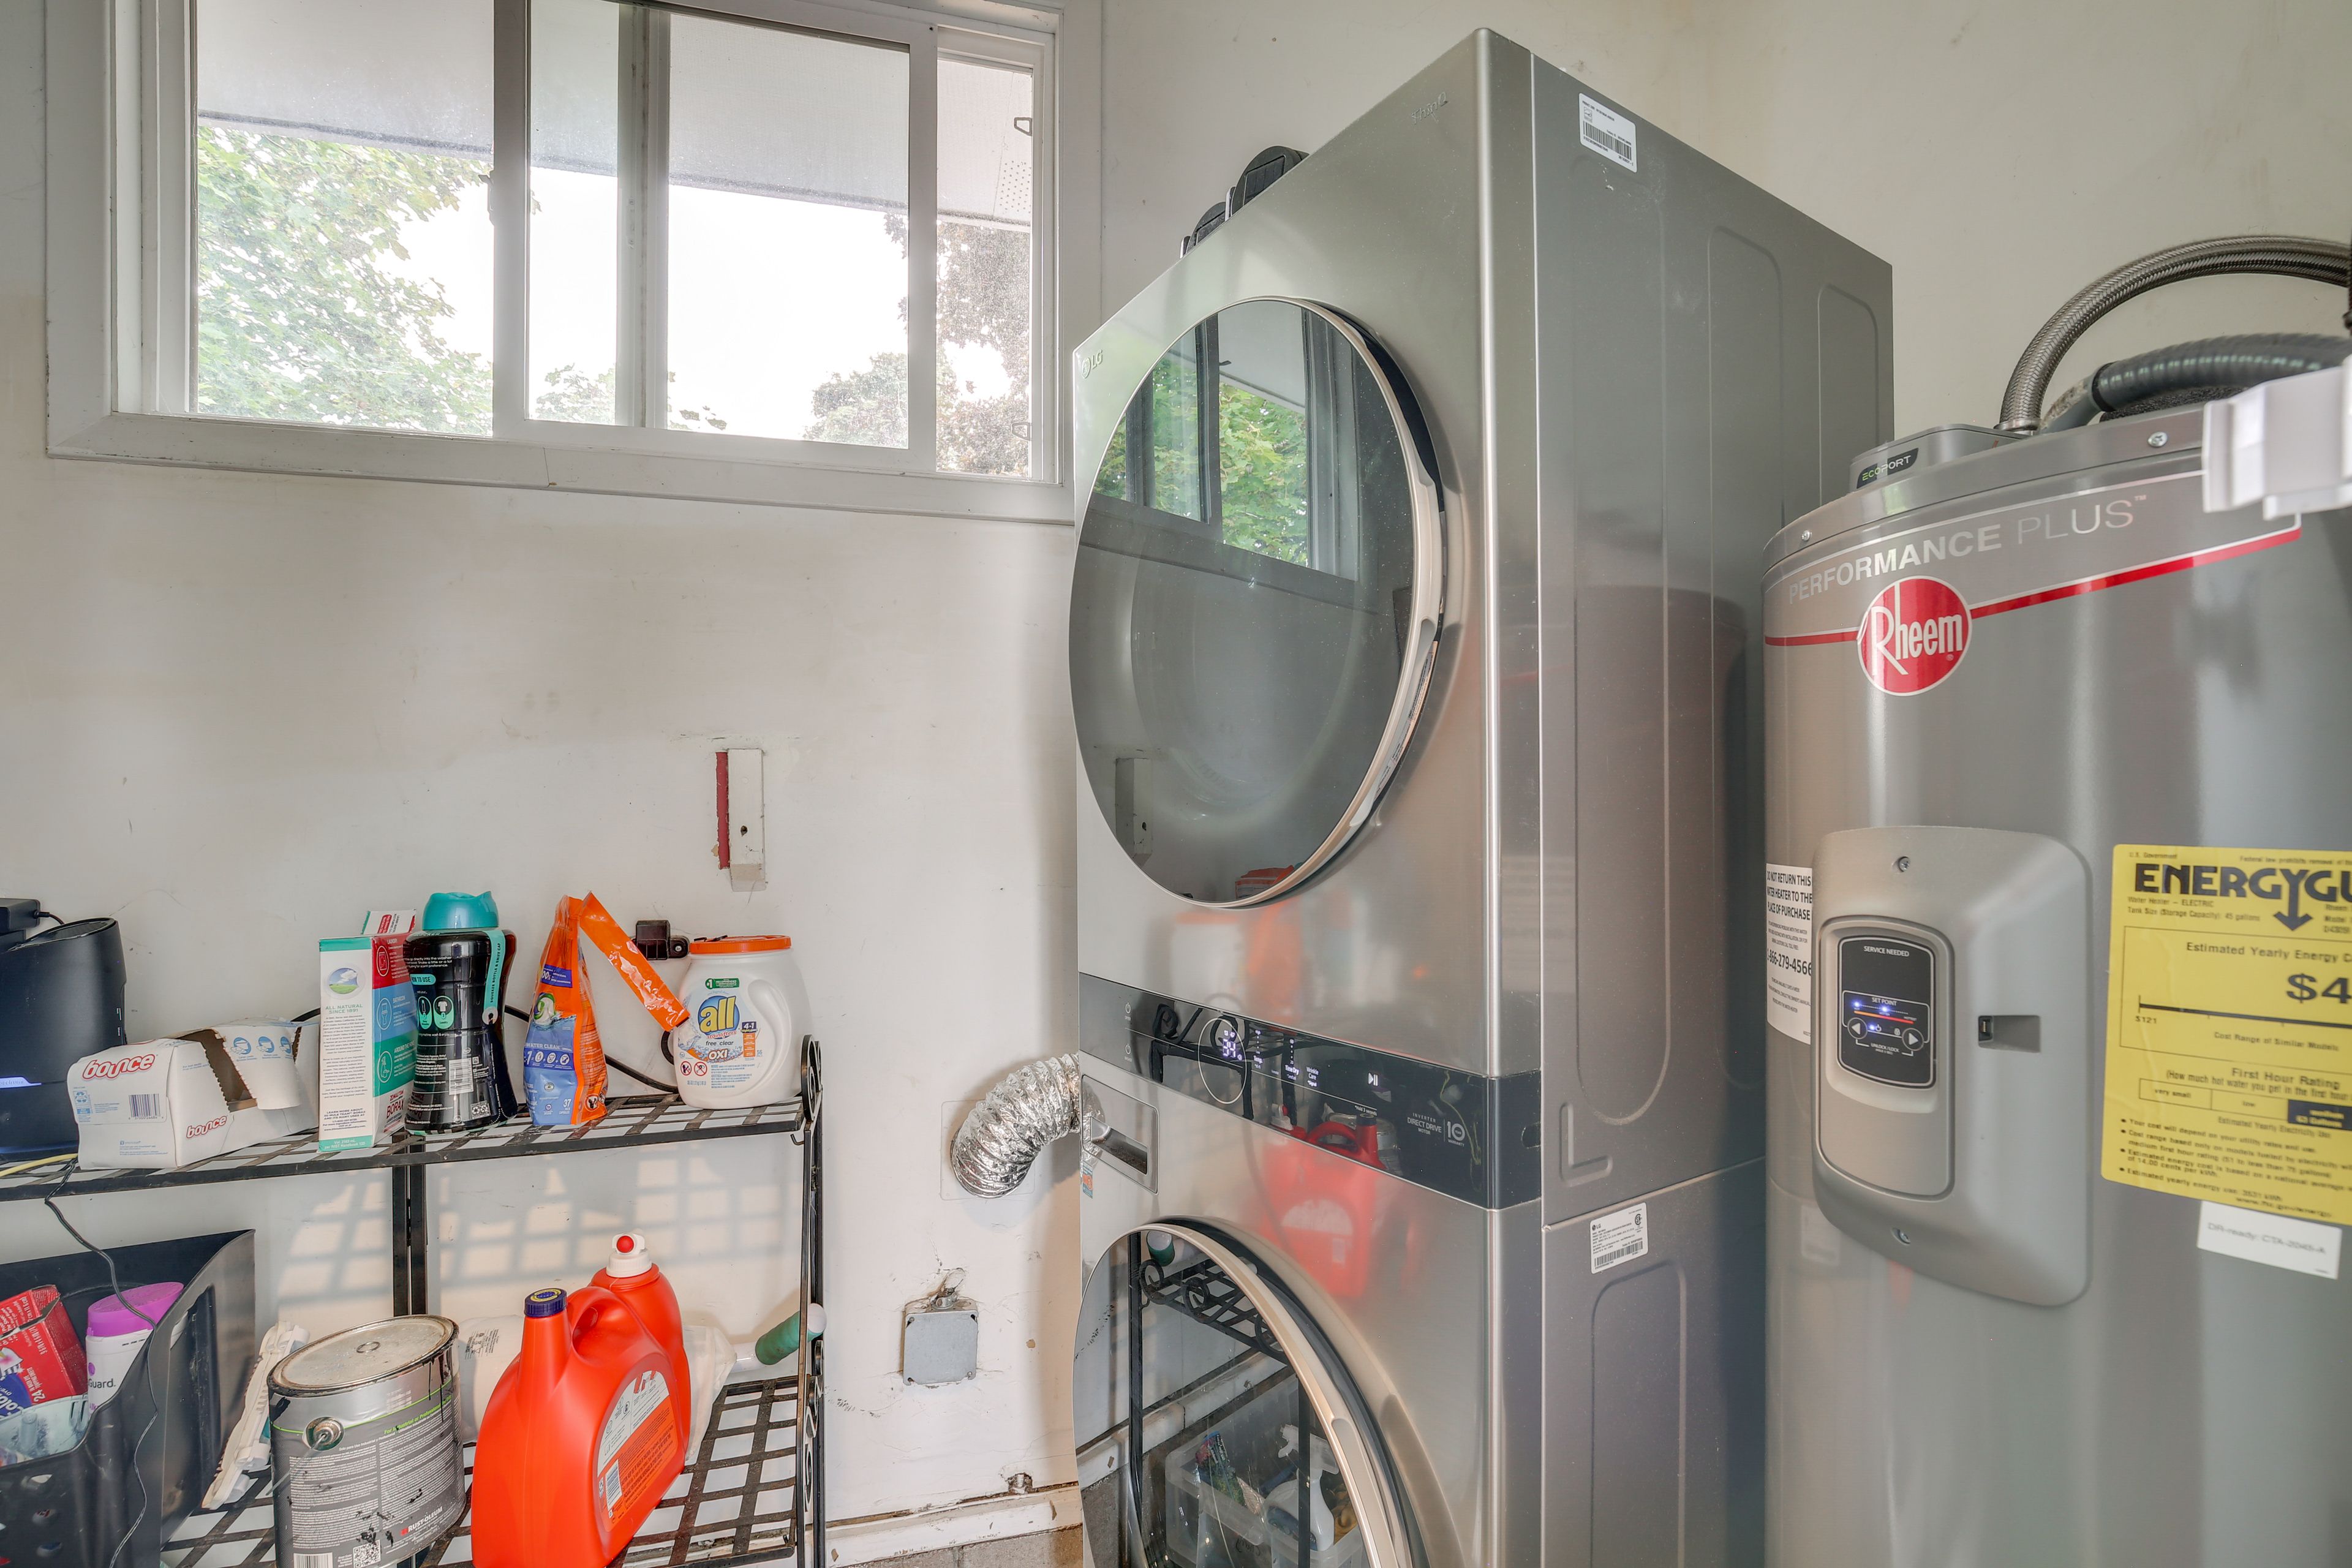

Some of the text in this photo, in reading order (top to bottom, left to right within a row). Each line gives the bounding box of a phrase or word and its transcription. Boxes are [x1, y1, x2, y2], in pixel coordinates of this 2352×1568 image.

[1091, 349, 1102, 369] LG
[1862, 455, 1911, 481] ECOPORT
[1789, 524, 2002, 604] PERFORMANCE
[1871, 580, 1963, 675] Rheem
[1777, 873, 1796, 885] RETURN
[1796, 875, 1811, 886] THIS
[1775, 888, 1791, 901] HEATER
[1792, 890, 1800, 902] TO
[1800, 892, 1813, 904] THE
[1776, 903, 1811, 921] OF PURCHASE
[1864, 945, 1910, 957] SERVICE NEEDED
[2187, 942, 2339, 963] Estimated Yearly Energy
[699, 995, 736, 1033] all
[707, 1030, 737, 1039] stainlifters
[2234, 1034, 2261, 1044] Range
[708, 1048, 728, 1061] OXI
[82, 1054, 156, 1080] bounce
[1306, 1066, 1319, 1076] Wrinkle
[2166, 1069, 2185, 1080] (How
[2188, 1074, 2209, 1084] much
[2232, 1067, 2340, 1090] First Hour Rating
[386, 1098, 405, 1119] BORAX
[563, 1099, 571, 1107] 37
[1407, 1117, 1442, 1133] DIRECT DRIVE
[1412, 1112, 1436, 1123] INVERTER
[186, 1115, 228, 1139] bounce
[1447, 1121, 1465, 1141] 10
[2179, 1128, 2206, 1136] depend
[1448, 1138, 1465, 1147] WARRANTY
[2128, 1140, 2157, 1150] medium
[2146, 1134, 2192, 1146] range based
[2127, 1167, 2190, 1186] Estimated yearly
[31, 1389, 47, 1403] 24
[408, 1506, 443, 1533] RUST-OLEUM
